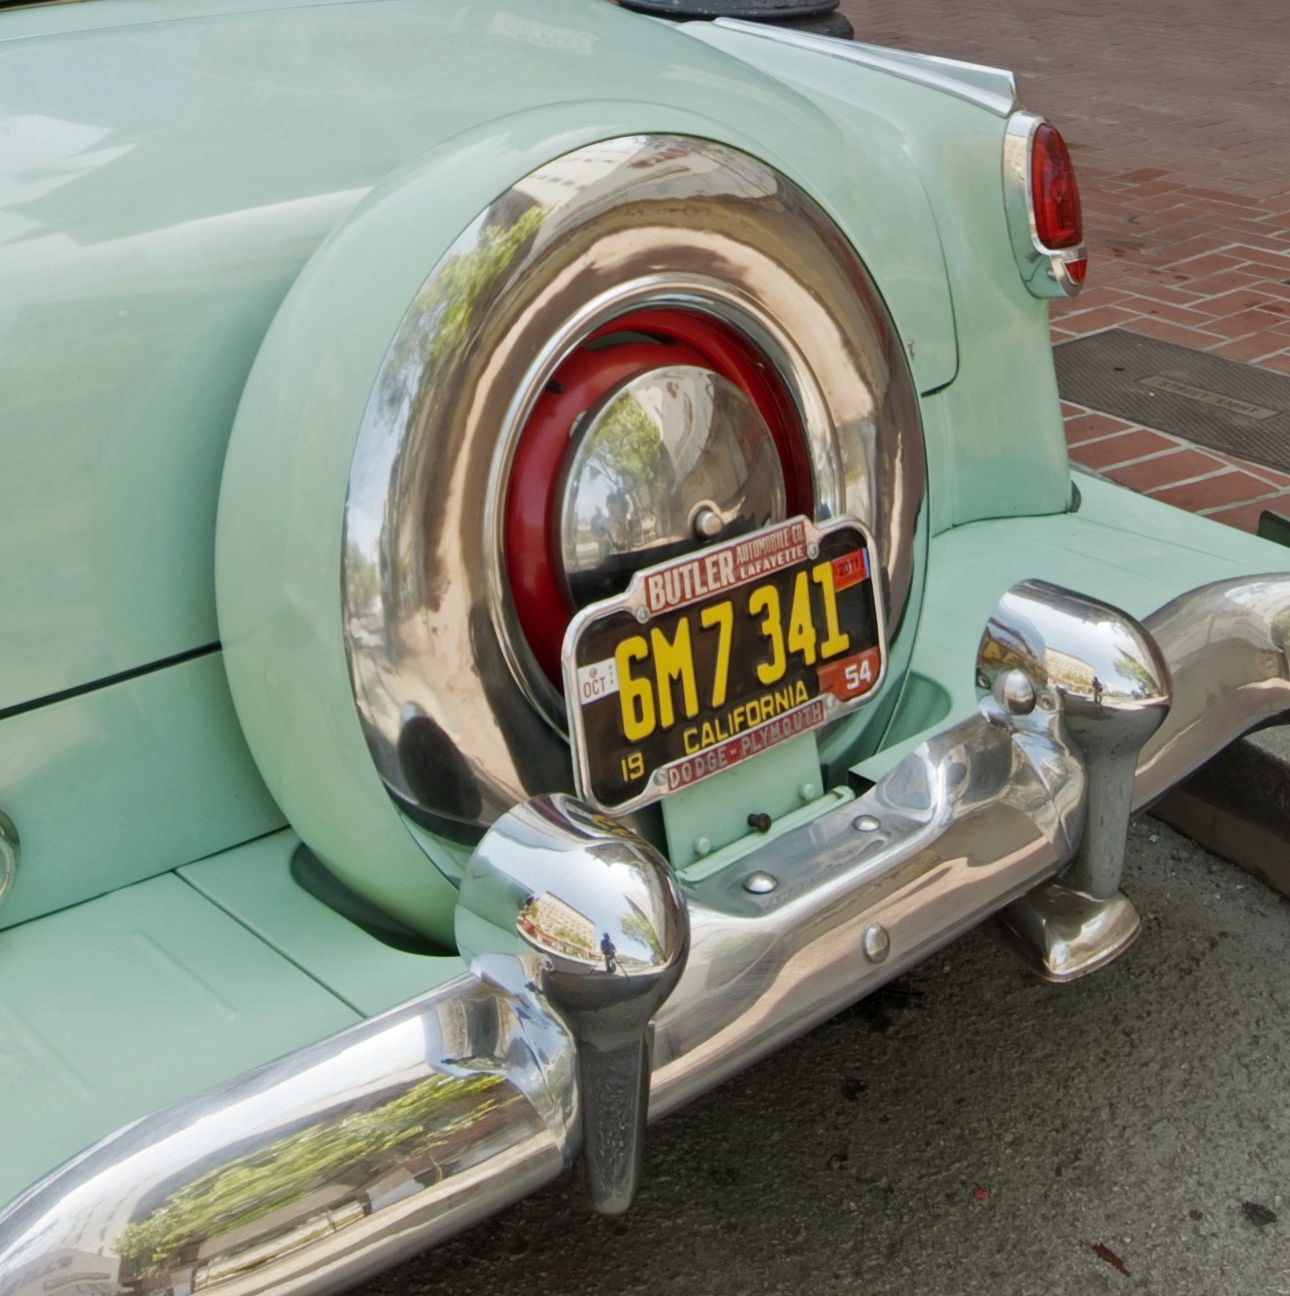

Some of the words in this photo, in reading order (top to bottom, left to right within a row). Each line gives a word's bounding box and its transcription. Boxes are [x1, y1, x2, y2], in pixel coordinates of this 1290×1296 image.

[737, 531, 790, 565] AUTOMOBILE
[740, 546, 804, 579] LAFAYETTE
[648, 551, 737, 612] BUTLER
[615, 601, 733, 743] 6M7
[749, 561, 850, 685] 341
[583, 676, 605, 698] OCT
[844, 661, 872, 691] 54
[683, 681, 809, 755] CALIFORNIA
[621, 753, 645, 783] 19
